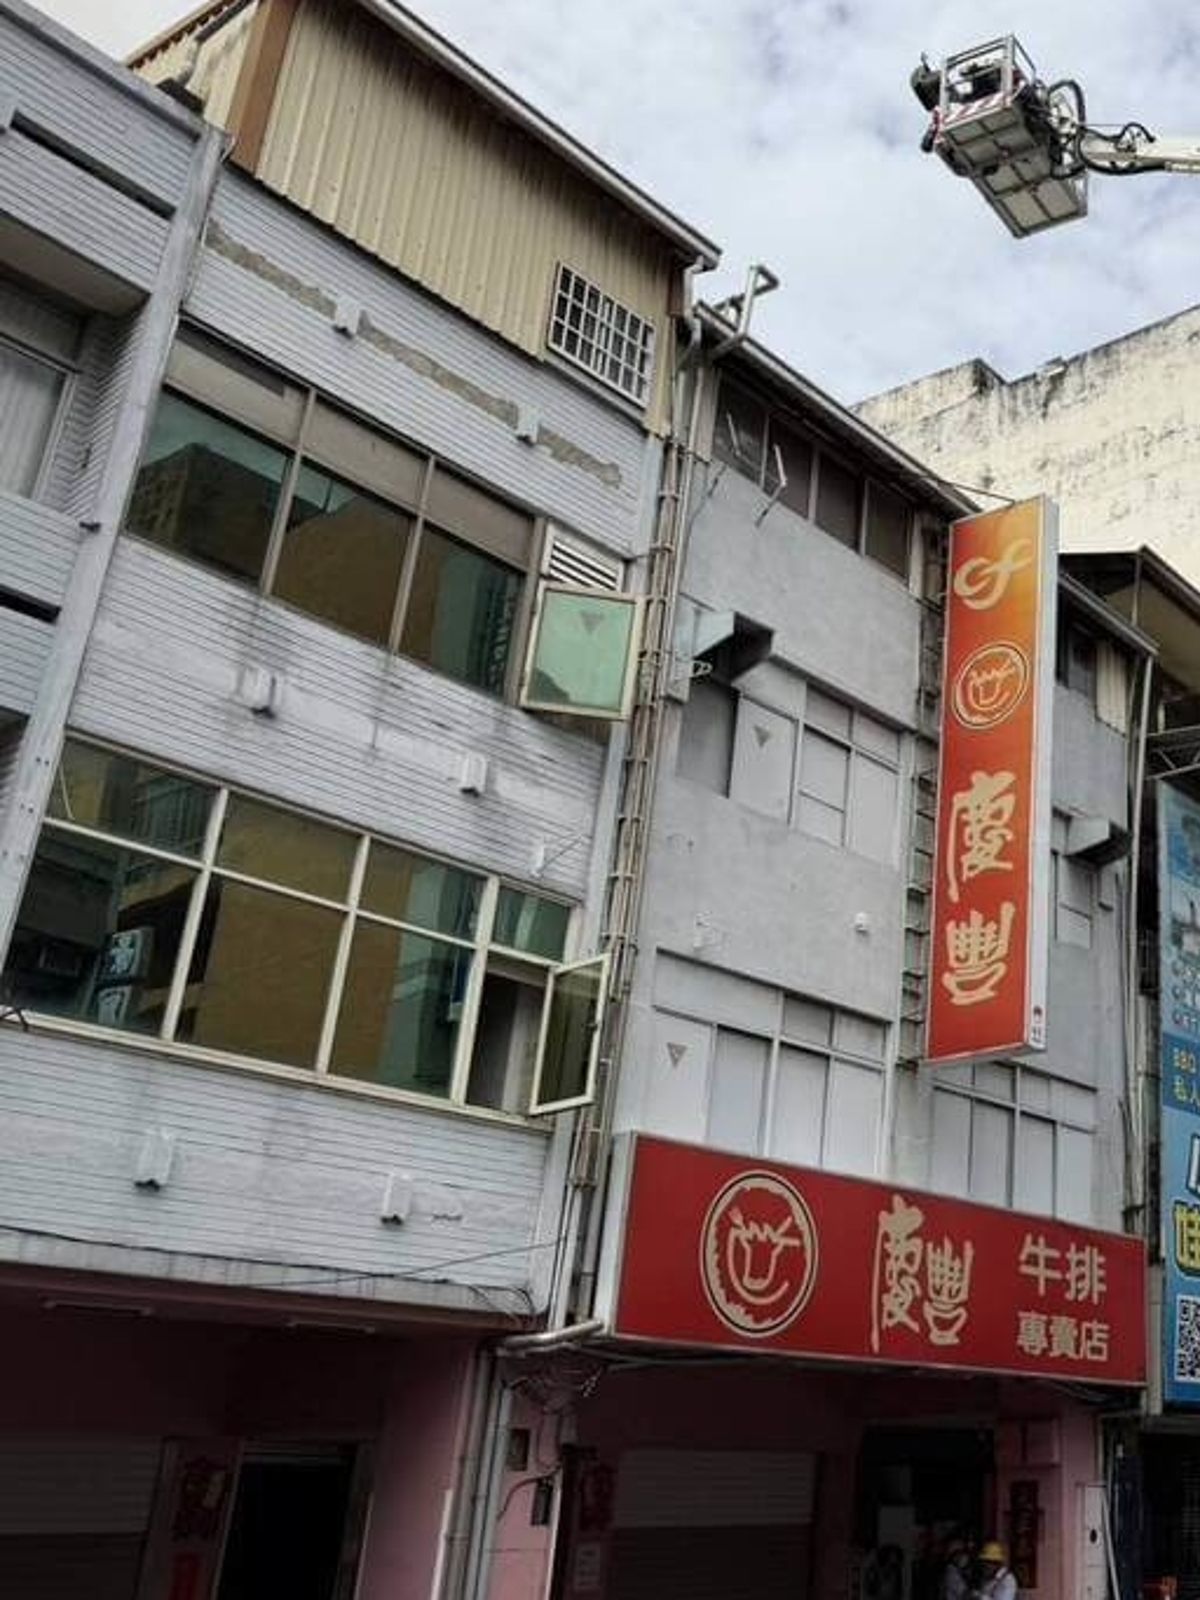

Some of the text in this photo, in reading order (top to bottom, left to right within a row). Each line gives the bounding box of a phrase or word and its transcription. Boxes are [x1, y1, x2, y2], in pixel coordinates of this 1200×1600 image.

[943, 769, 1016, 1006] 慶豐
[871, 1195, 973, 1353] 慶豐
[1018, 1232, 1107, 1306] 牛排
[1017, 1309, 1111, 1362] 專賣店
